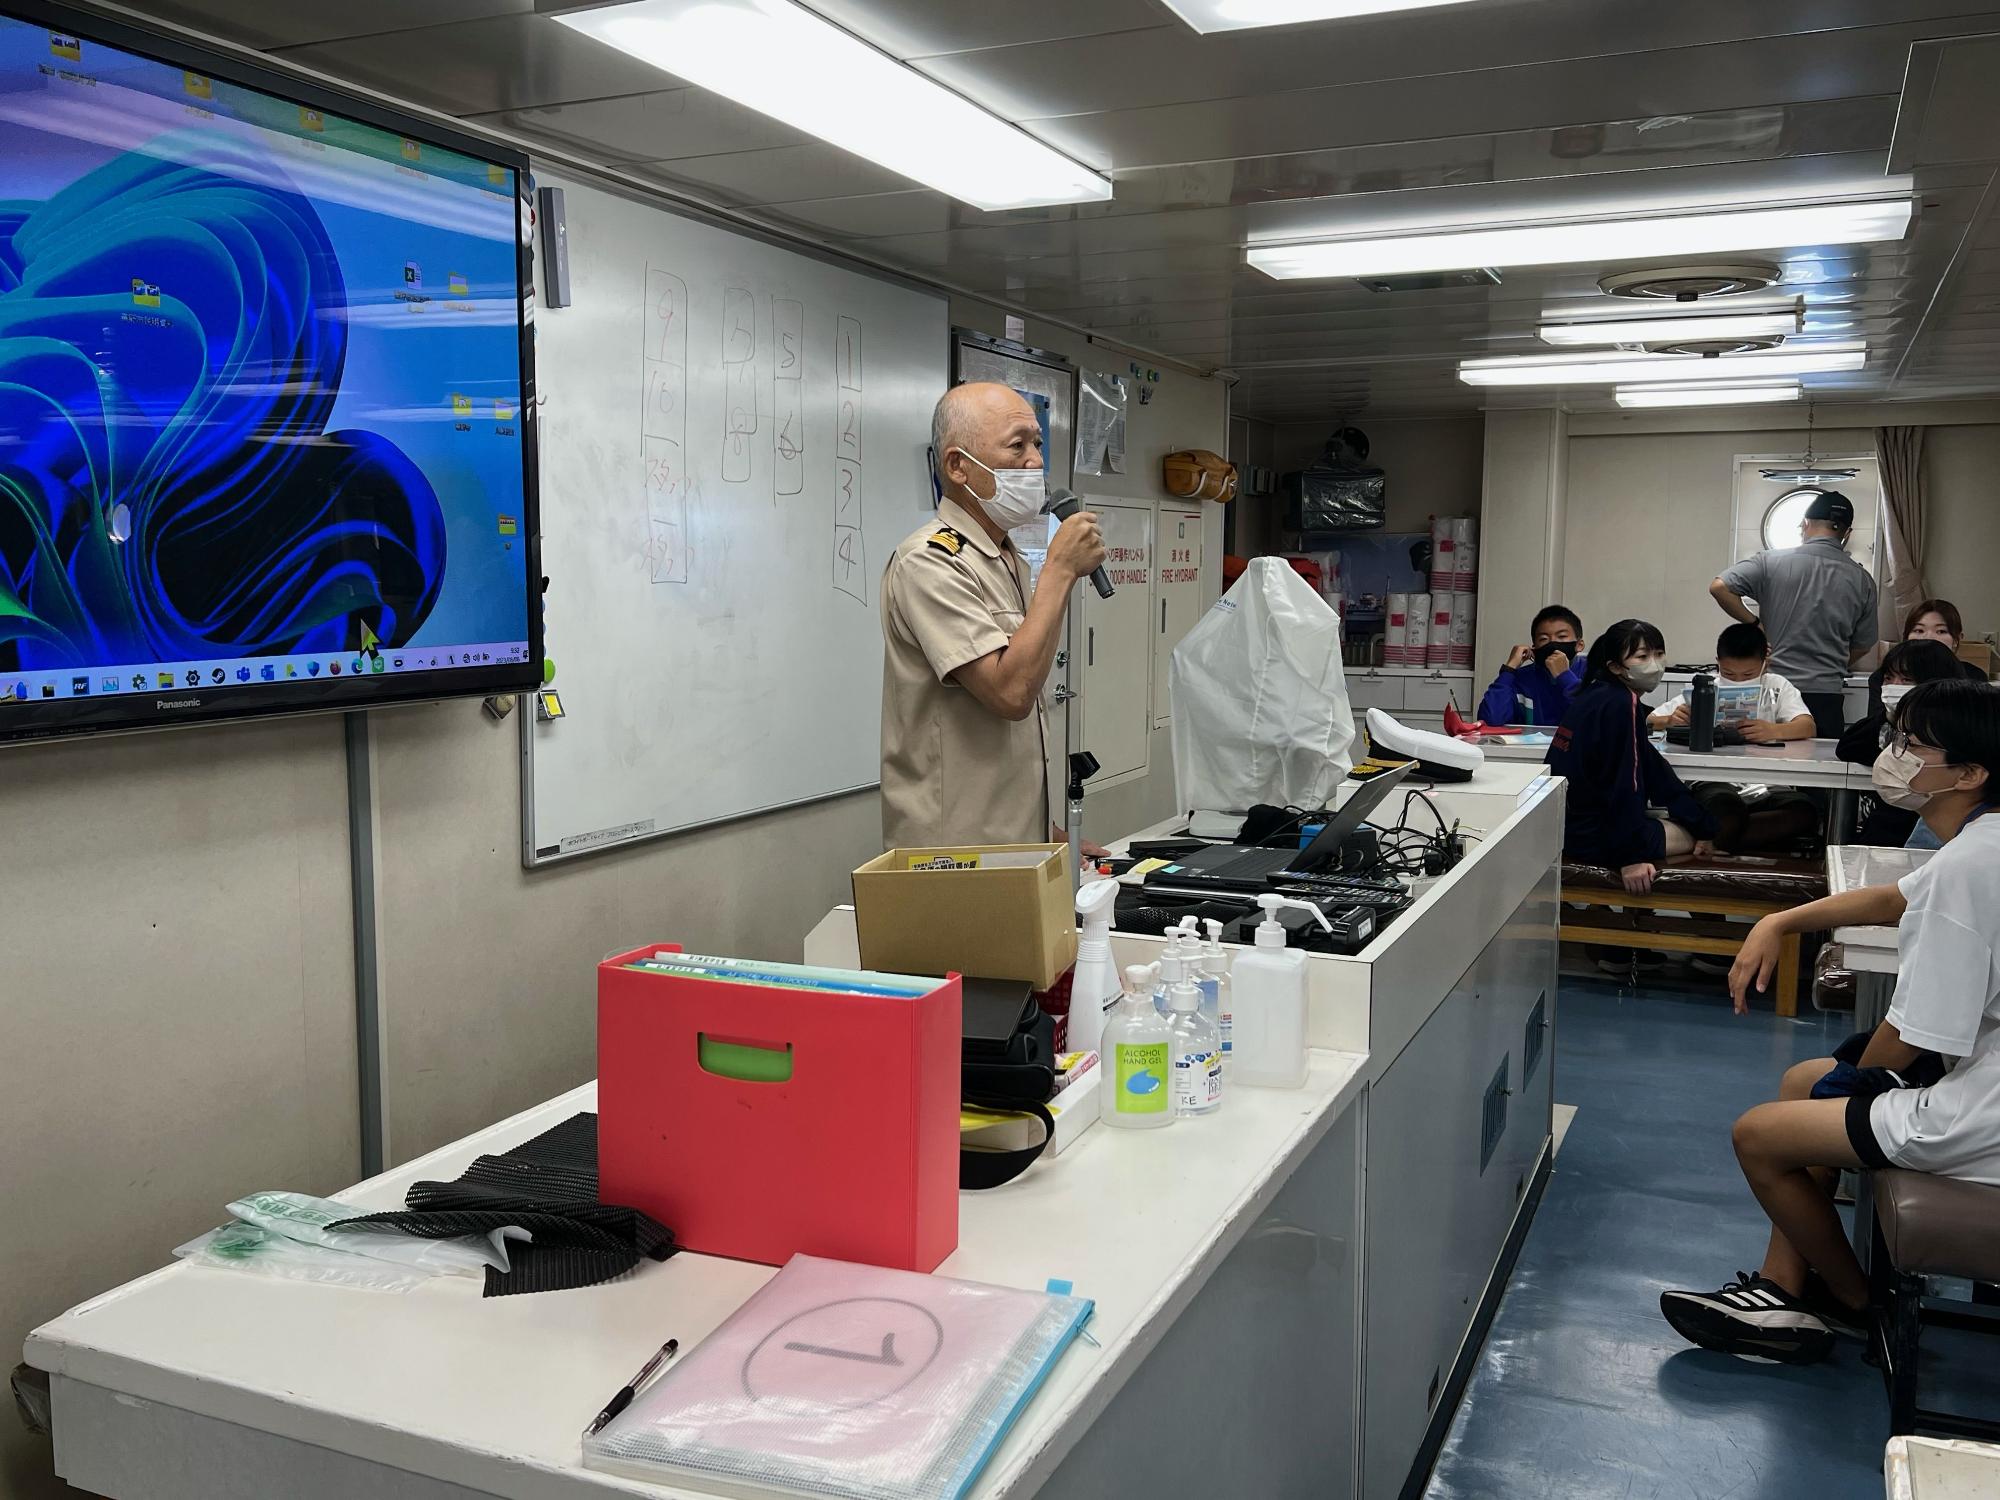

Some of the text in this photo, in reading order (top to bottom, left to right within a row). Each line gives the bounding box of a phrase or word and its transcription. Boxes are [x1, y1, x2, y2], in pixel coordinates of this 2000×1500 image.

[780, 332, 796, 369] 5
[842, 400, 856, 448] 2
[841, 468, 853, 513] 3
[838, 532, 857, 581] 4
[1109, 568, 1126, 585] DOOR
[1126, 568, 1147, 585] HANDLE
[1161, 567, 1198, 584] FIRE HYDRANT
[156, 698, 201, 710] Panasonic
[1123, 1056, 1162, 1065] HAND GEL
[1124, 1049, 1161, 1057] ALCOHOL
